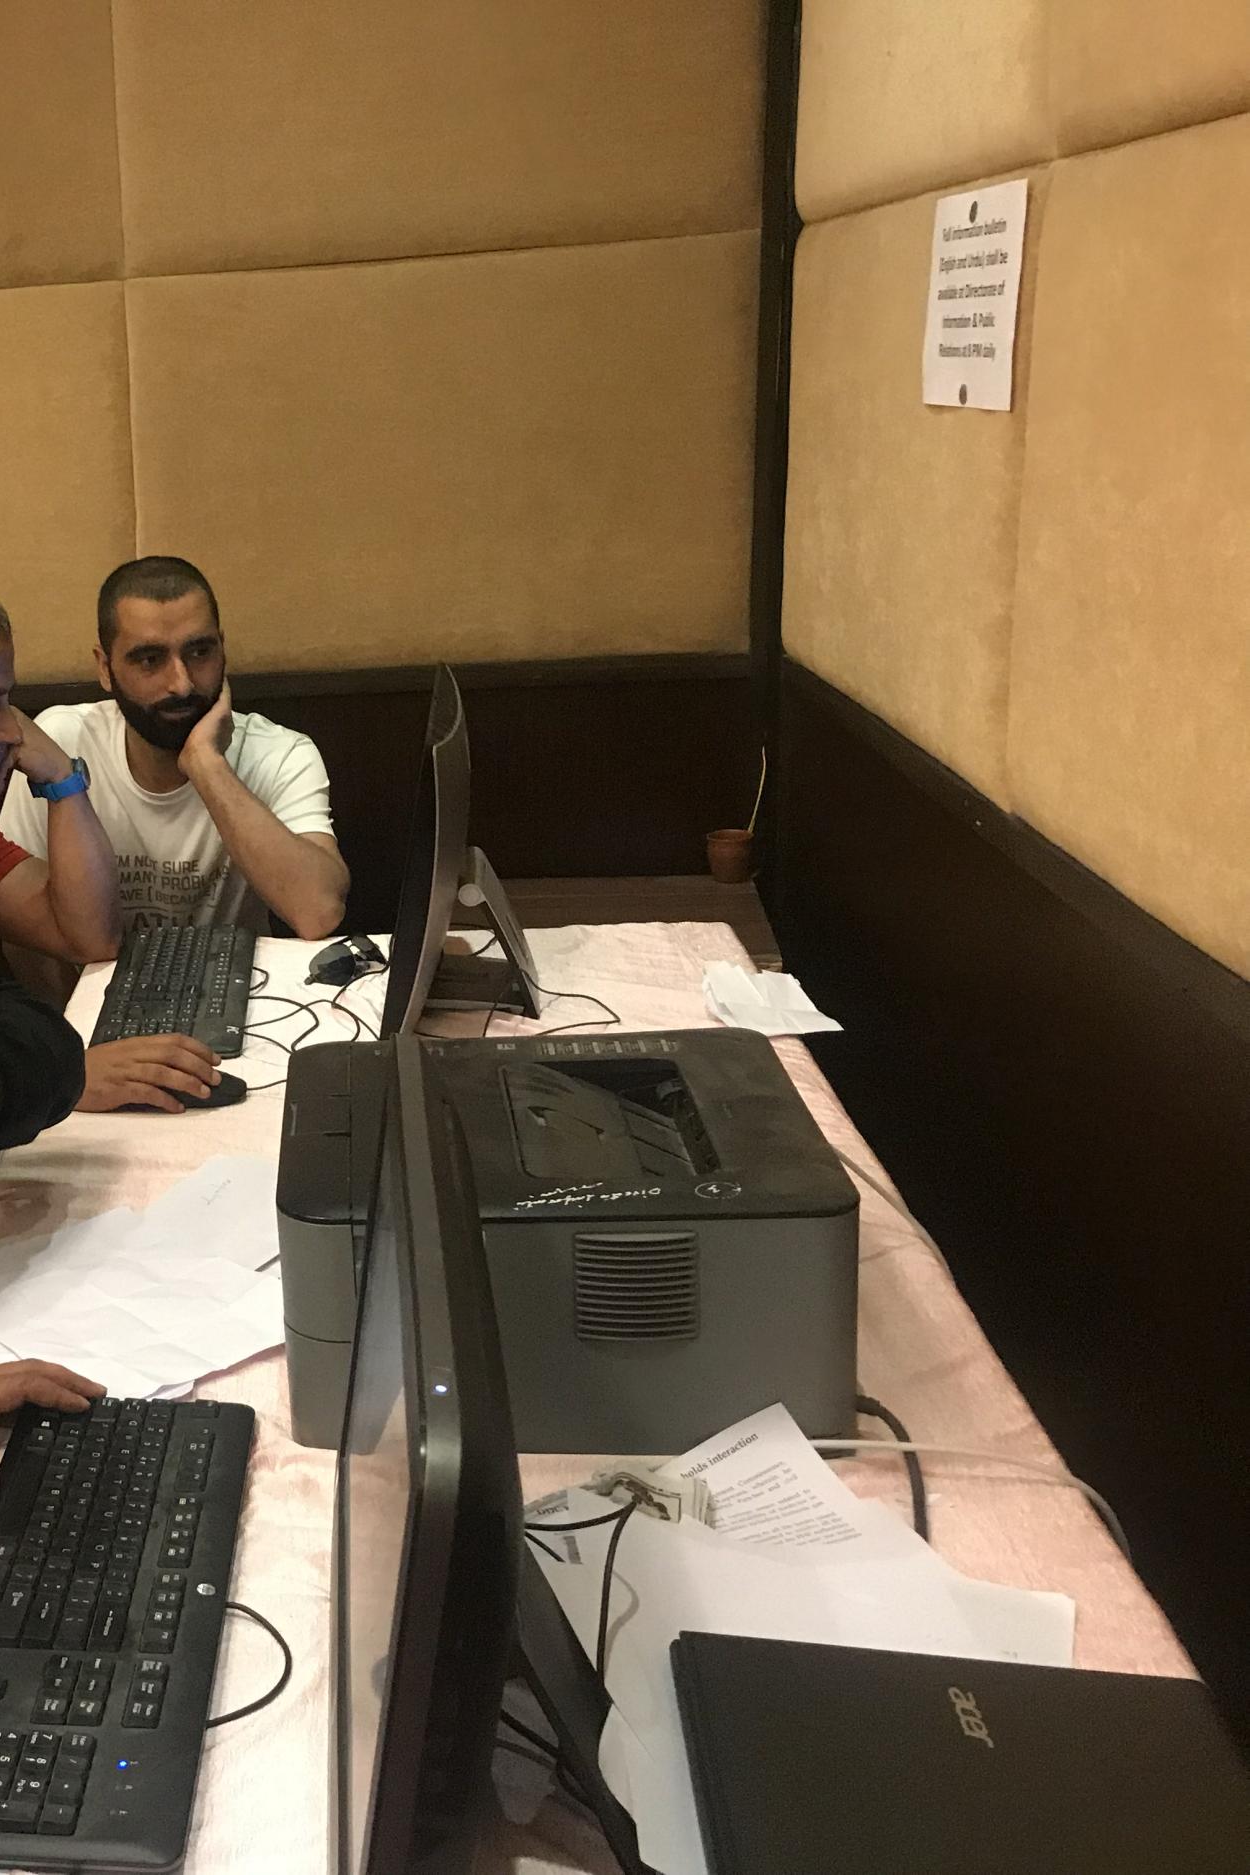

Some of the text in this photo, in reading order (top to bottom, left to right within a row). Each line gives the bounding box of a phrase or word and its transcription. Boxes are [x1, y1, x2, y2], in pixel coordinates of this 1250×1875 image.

[162, 859, 200, 874] SURE
[708, 1432, 759, 1466] interaction
[948, 1687, 995, 1748] acer
